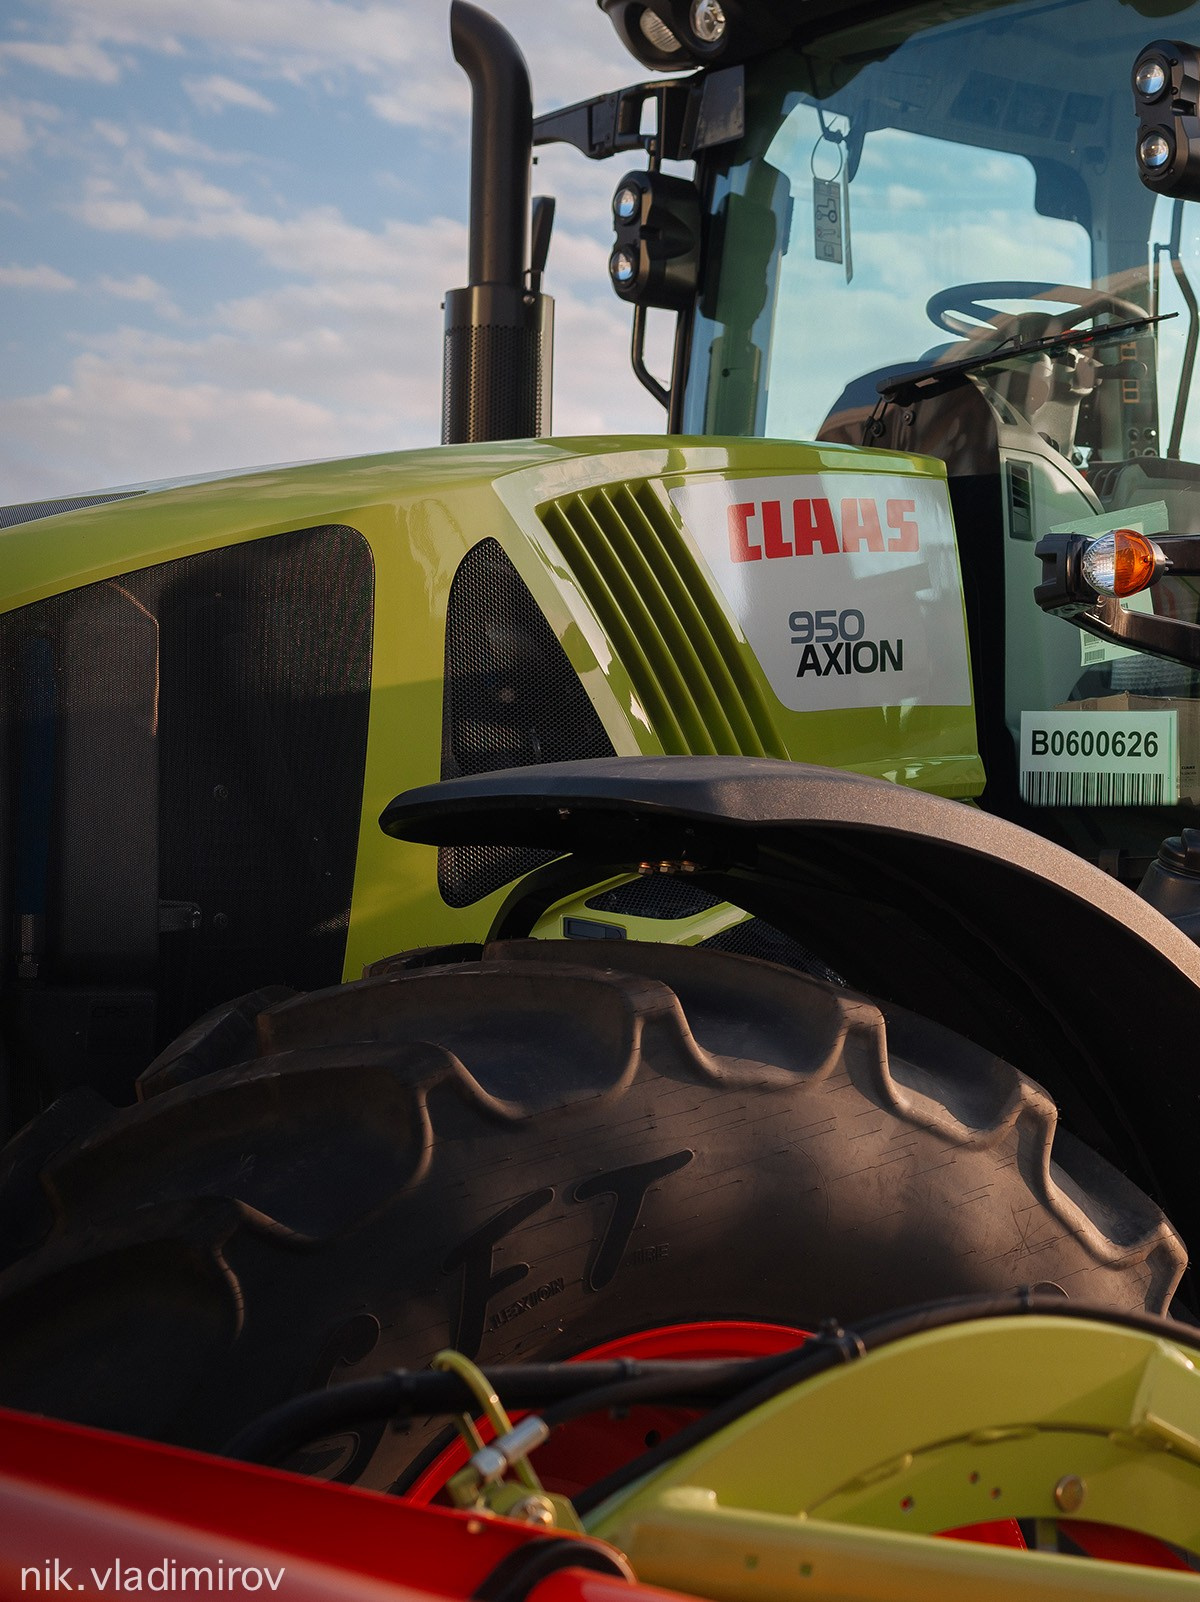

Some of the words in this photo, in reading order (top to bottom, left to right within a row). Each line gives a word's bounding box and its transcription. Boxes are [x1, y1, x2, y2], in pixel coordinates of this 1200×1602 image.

[726, 497, 919, 564] CLAAS
[788, 608, 865, 645] 950
[796, 638, 903, 678] AXION
[1031, 728, 1159, 759] B0600626
